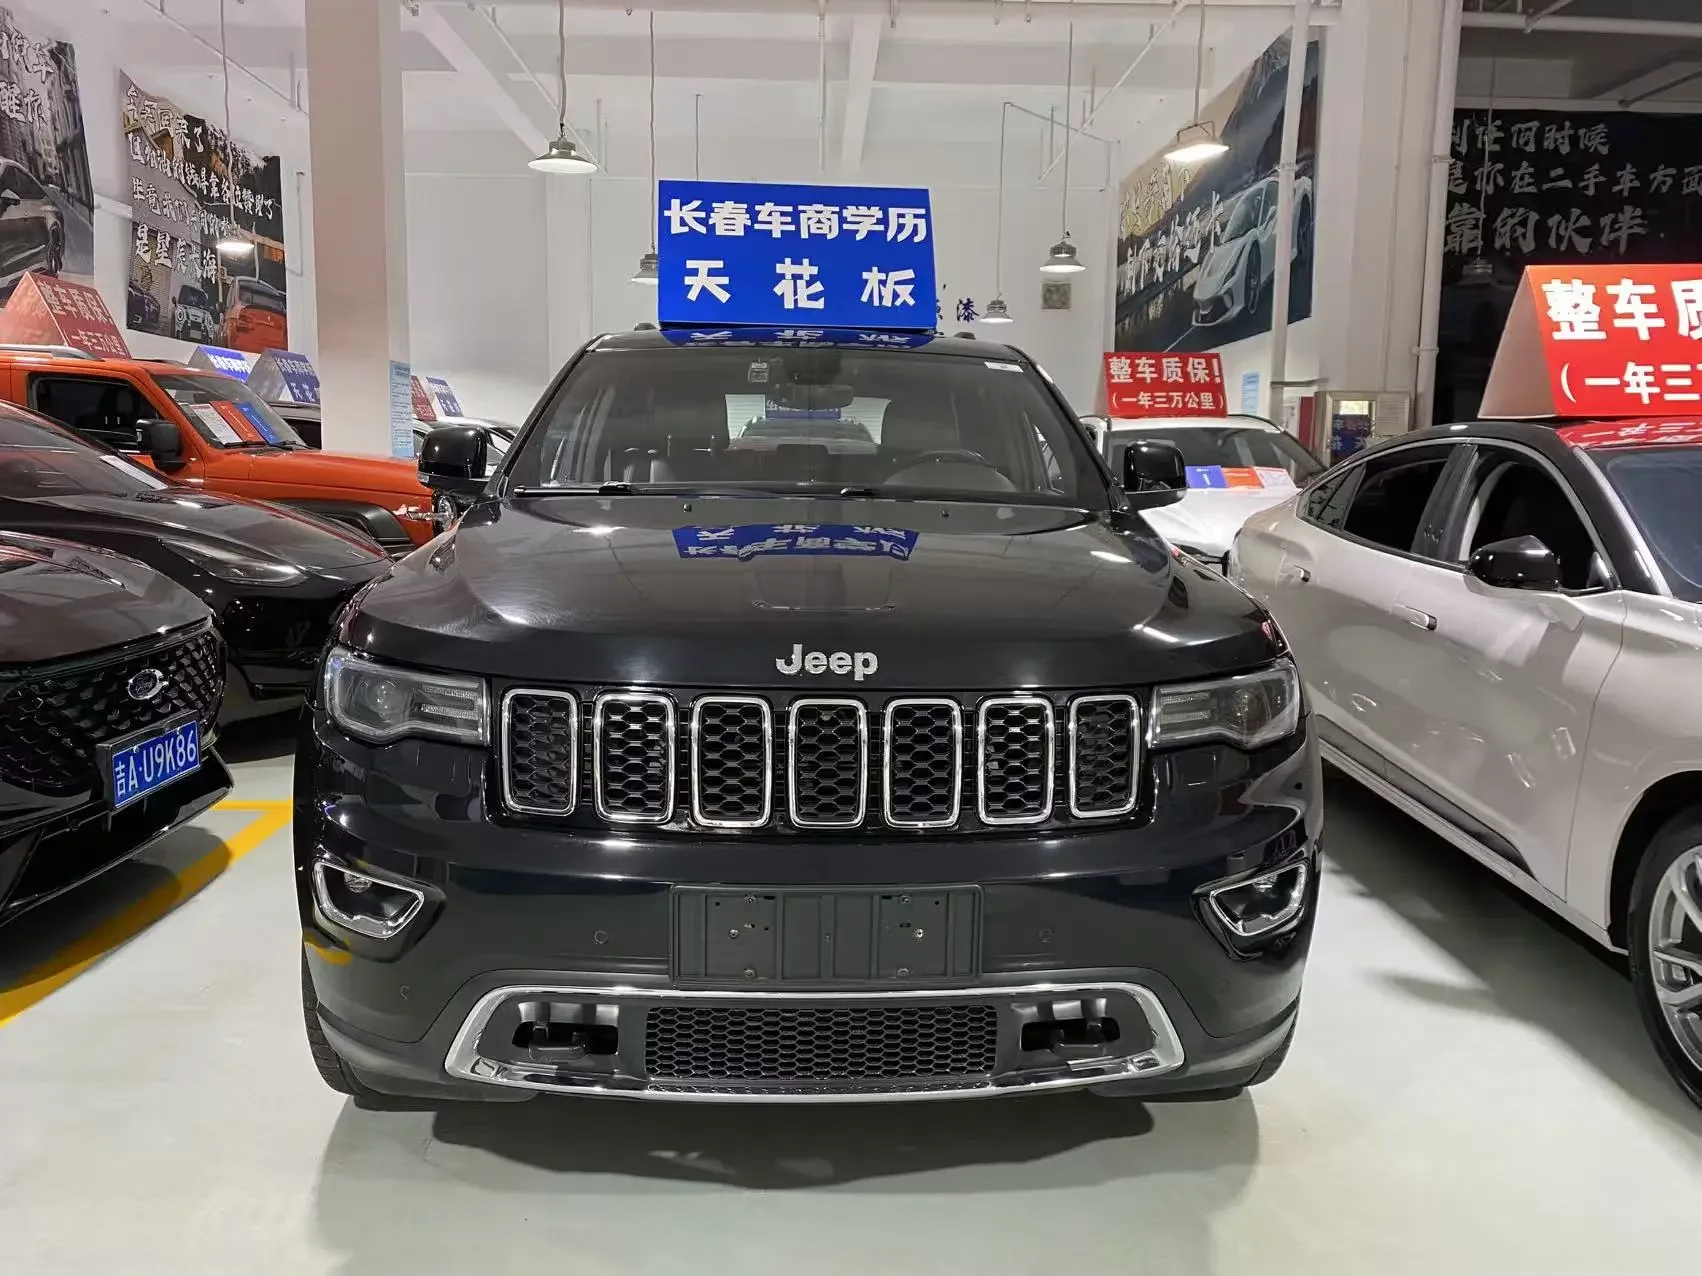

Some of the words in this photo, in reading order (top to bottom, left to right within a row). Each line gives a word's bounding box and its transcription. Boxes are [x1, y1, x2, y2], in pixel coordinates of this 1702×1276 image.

[663, 198, 927, 243] 长春车商学历
[684, 258, 915, 309] 天花板
[956, 298, 979, 322] 漆
[1108, 356, 1221, 384] 整车质保!
[1560, 361, 1702, 405] （一年三
[1112, 391, 1224, 409] （一年三万公里）
[775, 643, 879, 681] Jeep
